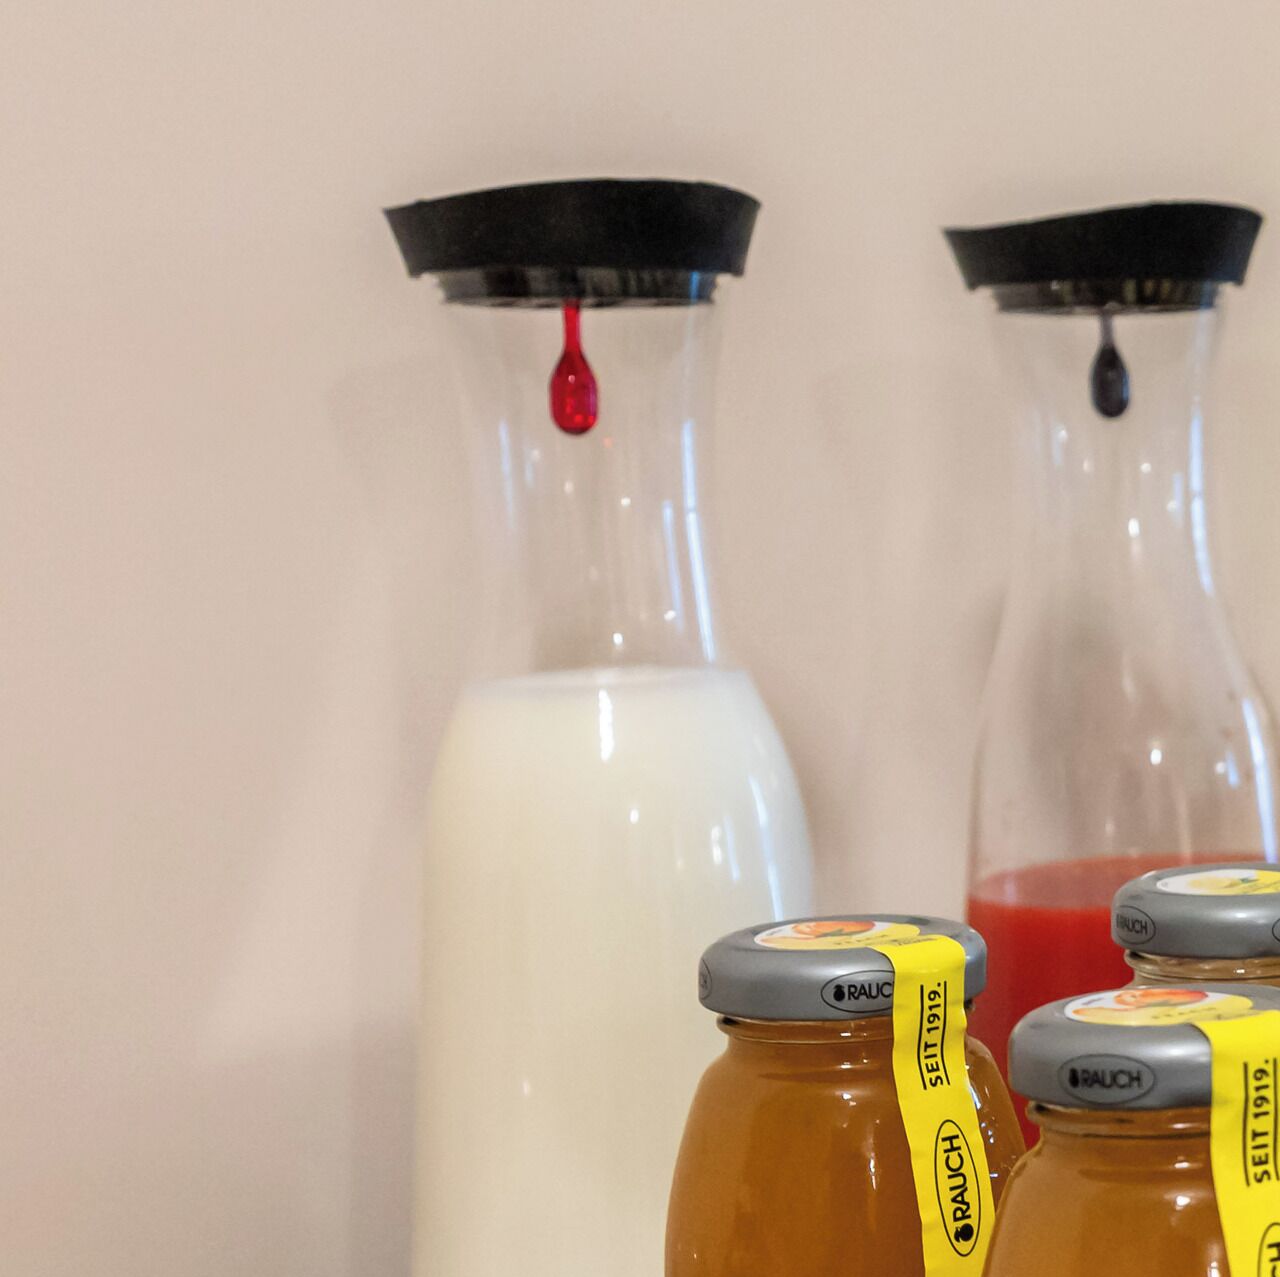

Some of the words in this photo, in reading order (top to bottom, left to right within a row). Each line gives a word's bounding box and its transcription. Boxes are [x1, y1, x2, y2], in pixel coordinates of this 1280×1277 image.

[1119, 915, 1148, 936] RAUCH
[848, 982, 894, 1001] RAUC
[926, 982, 942, 1035] 1919.
[924, 1040, 944, 1087] SEIT
[1081, 1069, 1143, 1089] RAUCH
[1252, 1058, 1271, 1119] 1919.
[941, 1134, 972, 1222] RAUCH
[1251, 1128, 1271, 1183] SEIT
